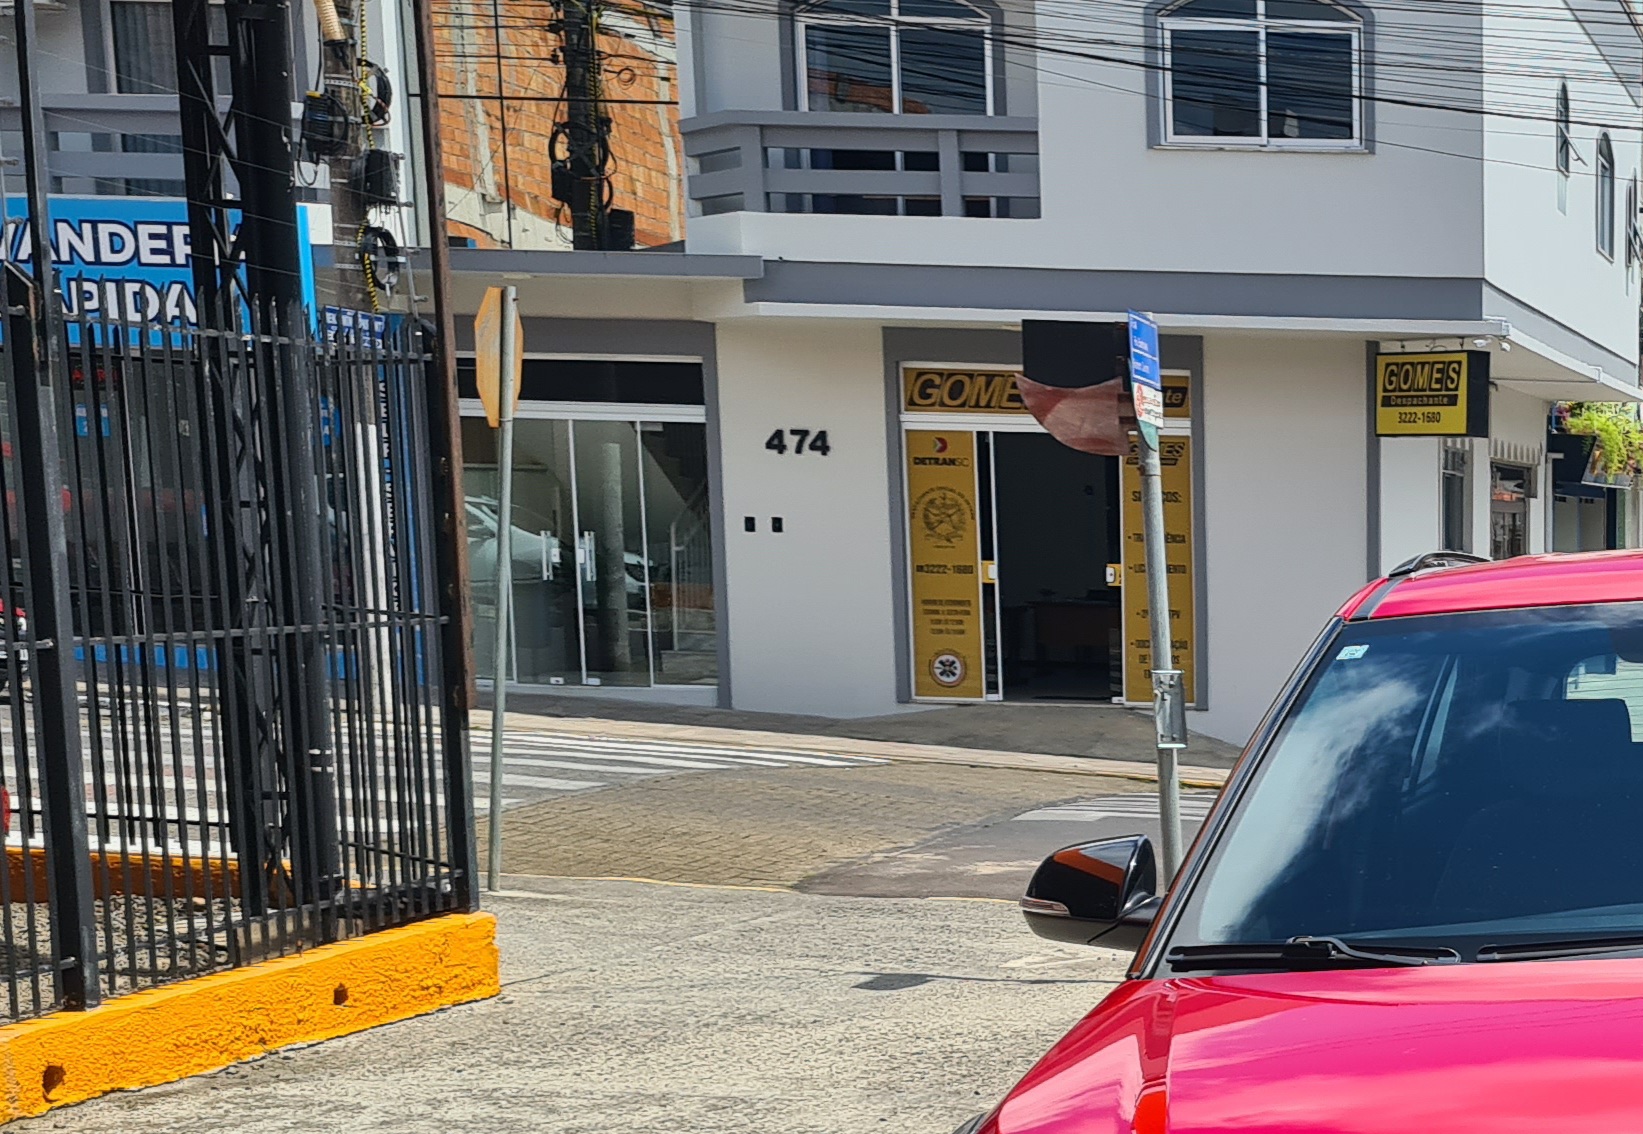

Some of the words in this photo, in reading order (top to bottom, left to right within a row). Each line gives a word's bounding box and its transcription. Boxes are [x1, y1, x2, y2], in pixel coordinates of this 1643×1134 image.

[1384, 362, 1460, 391] GOMES
[1390, 395, 1449, 407] Despachante
[765, 429, 831, 456] 474
